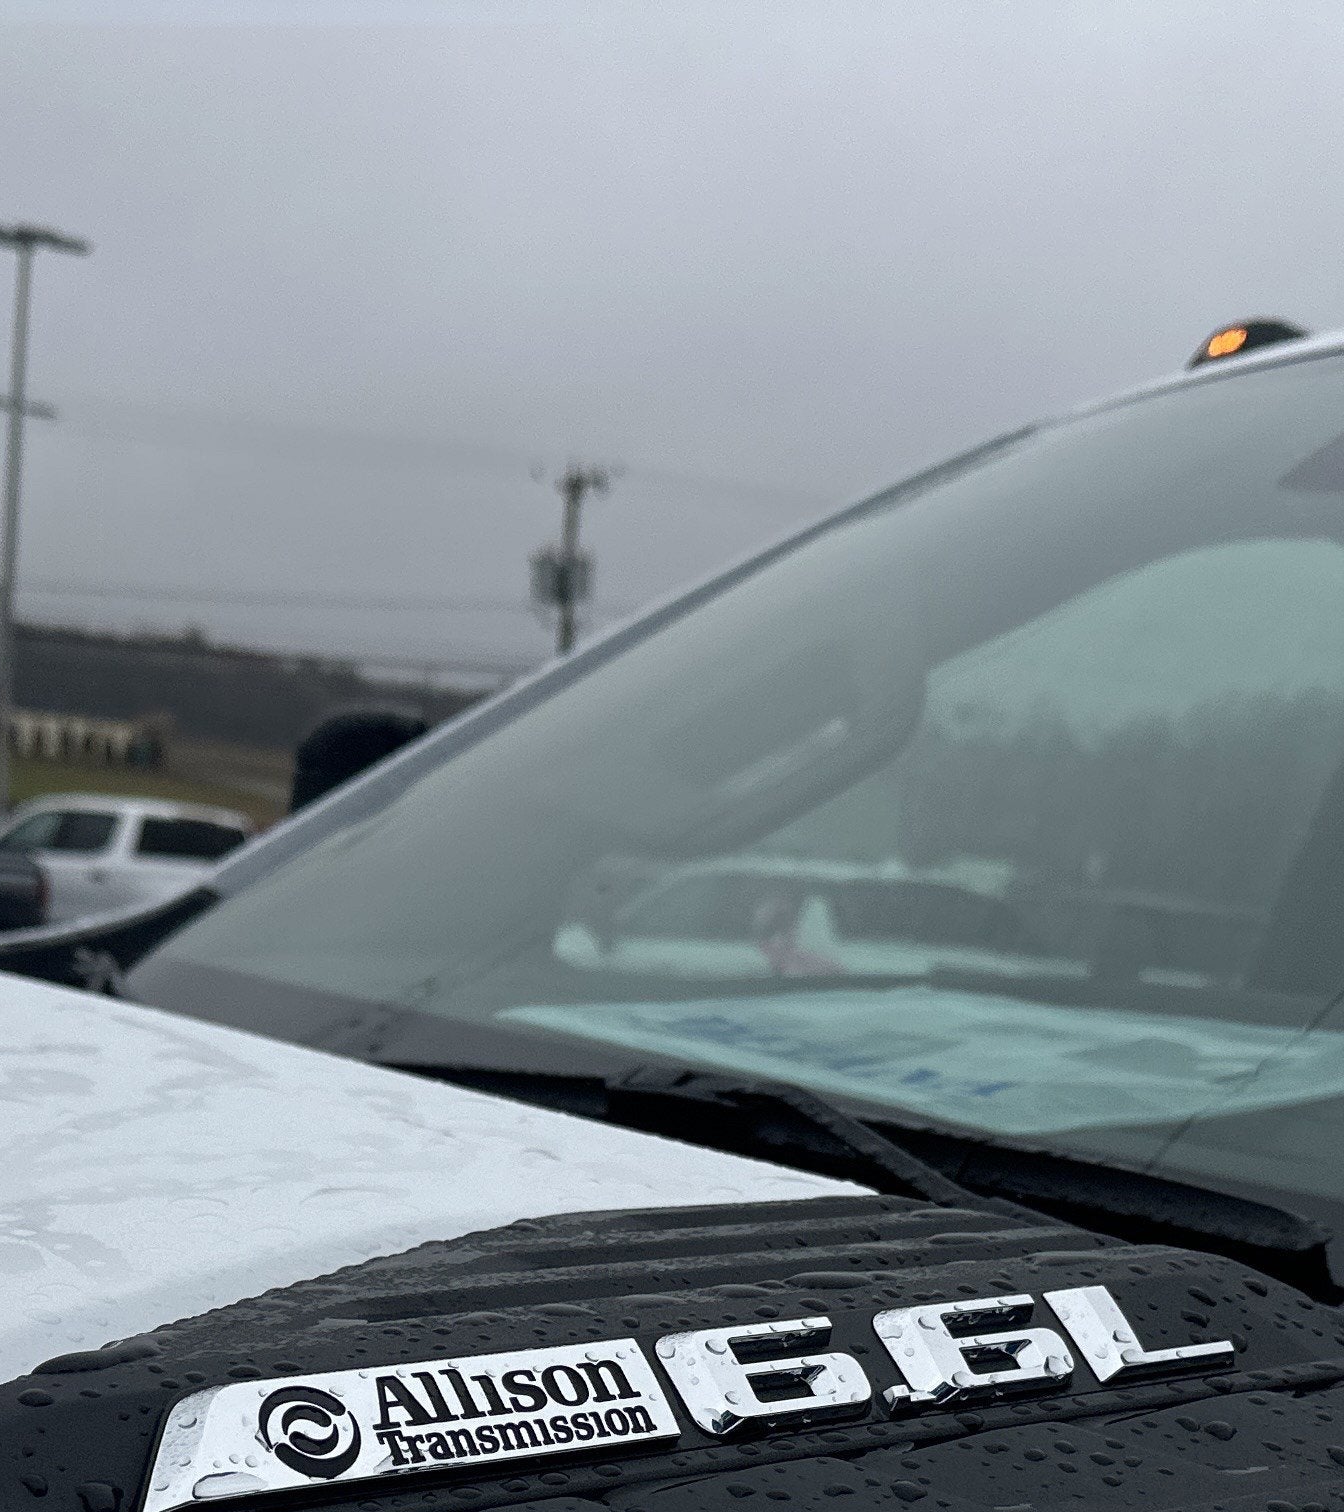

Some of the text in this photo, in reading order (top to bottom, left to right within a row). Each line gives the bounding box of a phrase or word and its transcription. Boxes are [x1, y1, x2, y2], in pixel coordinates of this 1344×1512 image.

[372, 1359, 643, 1431] Allison
[655, 1285, 1236, 1436] 6.6L
[375, 1403, 659, 1468] Transmission
